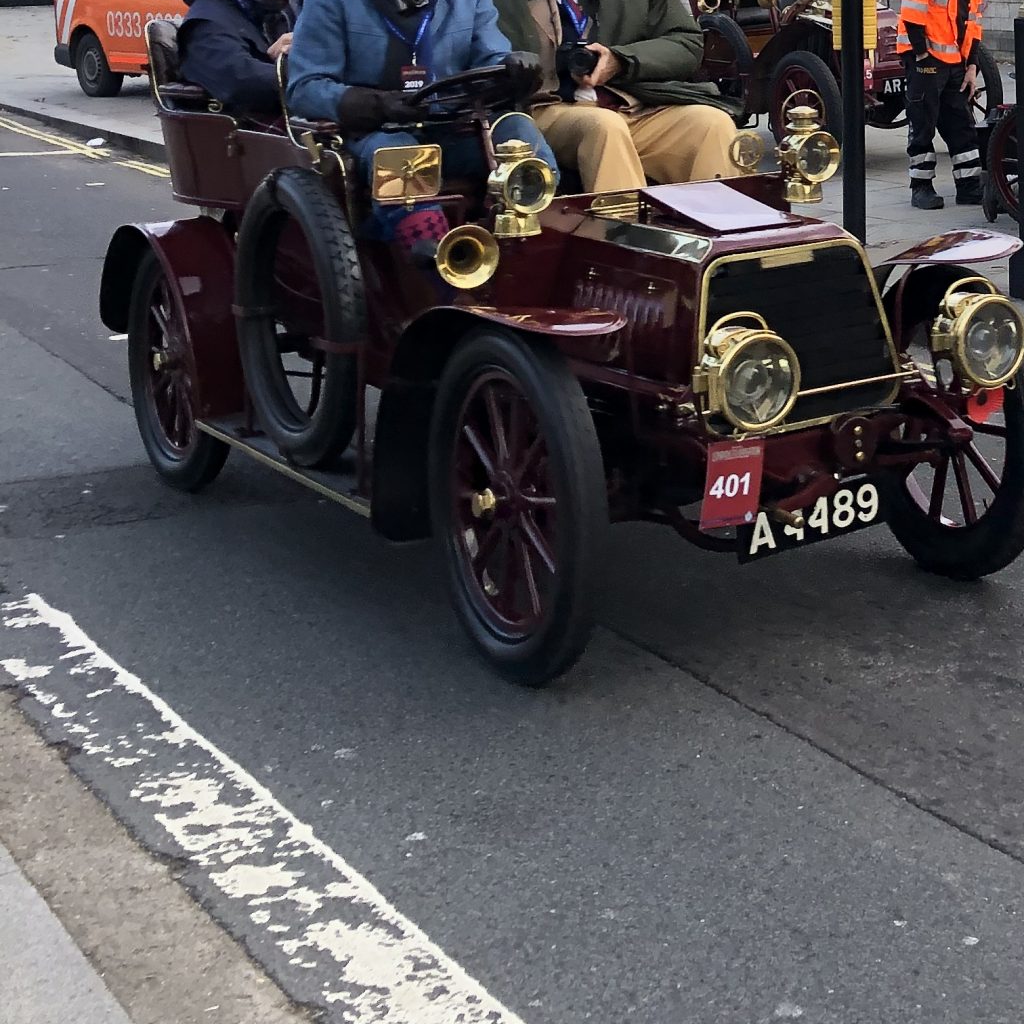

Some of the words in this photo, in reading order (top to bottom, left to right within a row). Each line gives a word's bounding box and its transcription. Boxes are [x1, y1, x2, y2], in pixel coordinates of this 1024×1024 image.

[106, 10, 142, 38] 0333
[404, 80, 424, 89] 2019
[709, 472, 751, 499] 401
